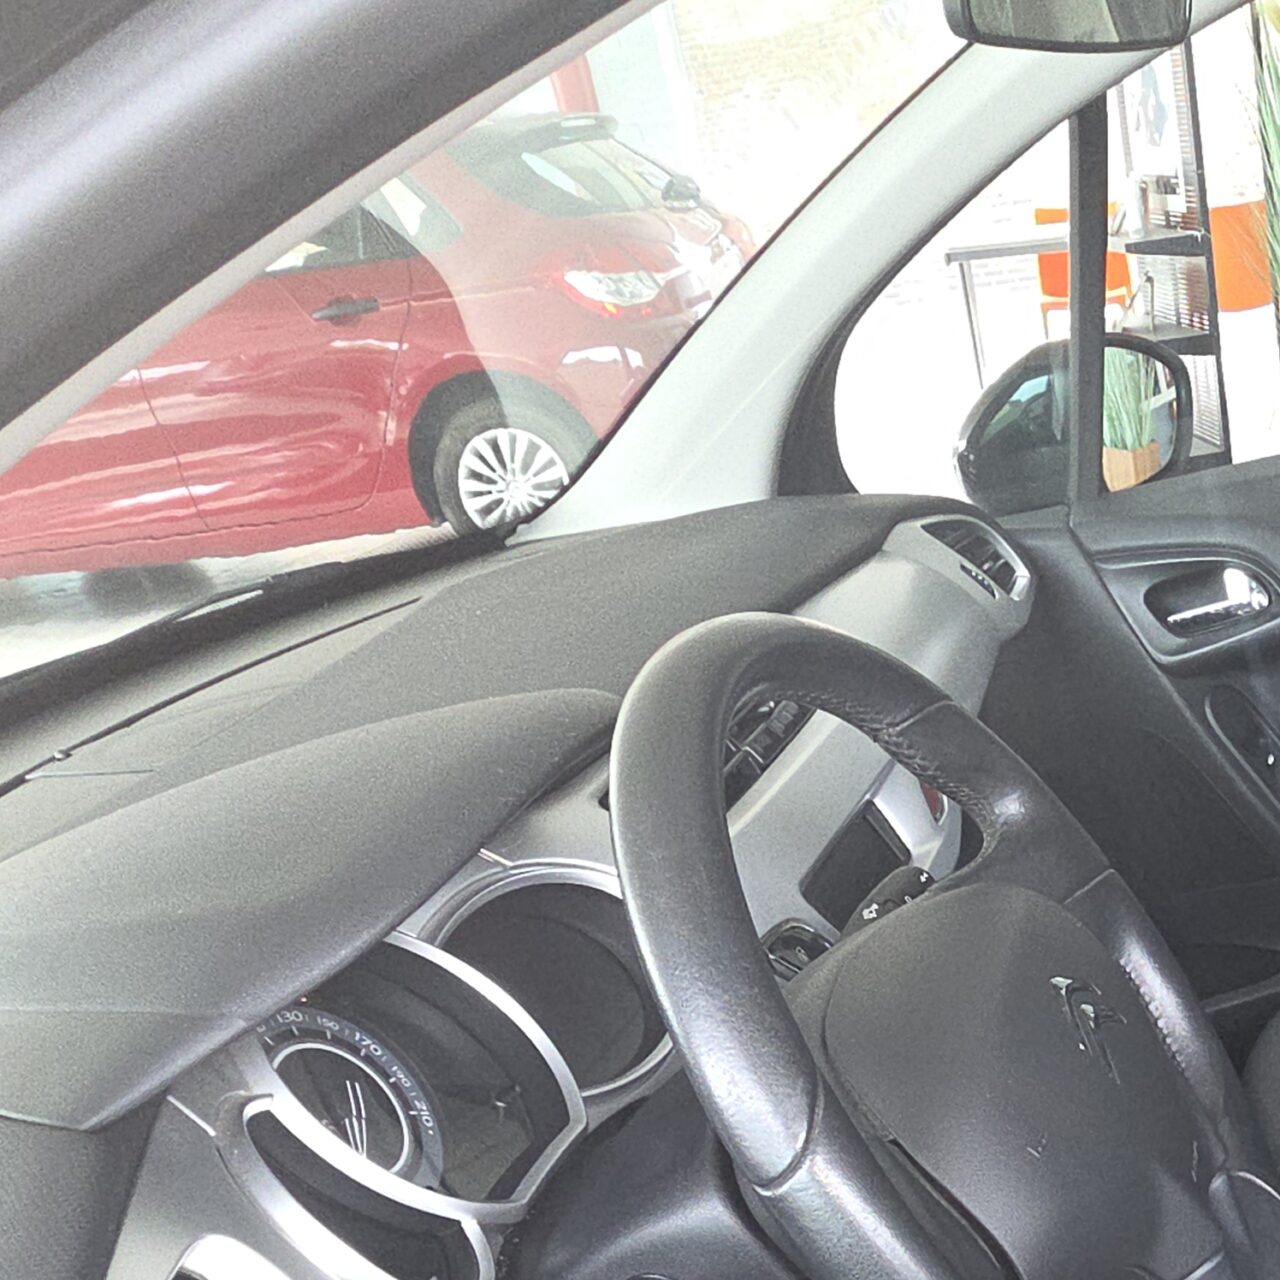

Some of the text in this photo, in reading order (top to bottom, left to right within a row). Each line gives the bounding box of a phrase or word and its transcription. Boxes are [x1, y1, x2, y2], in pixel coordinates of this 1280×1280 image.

[276, 1010, 434, 1127] 130 150 170 190 210
